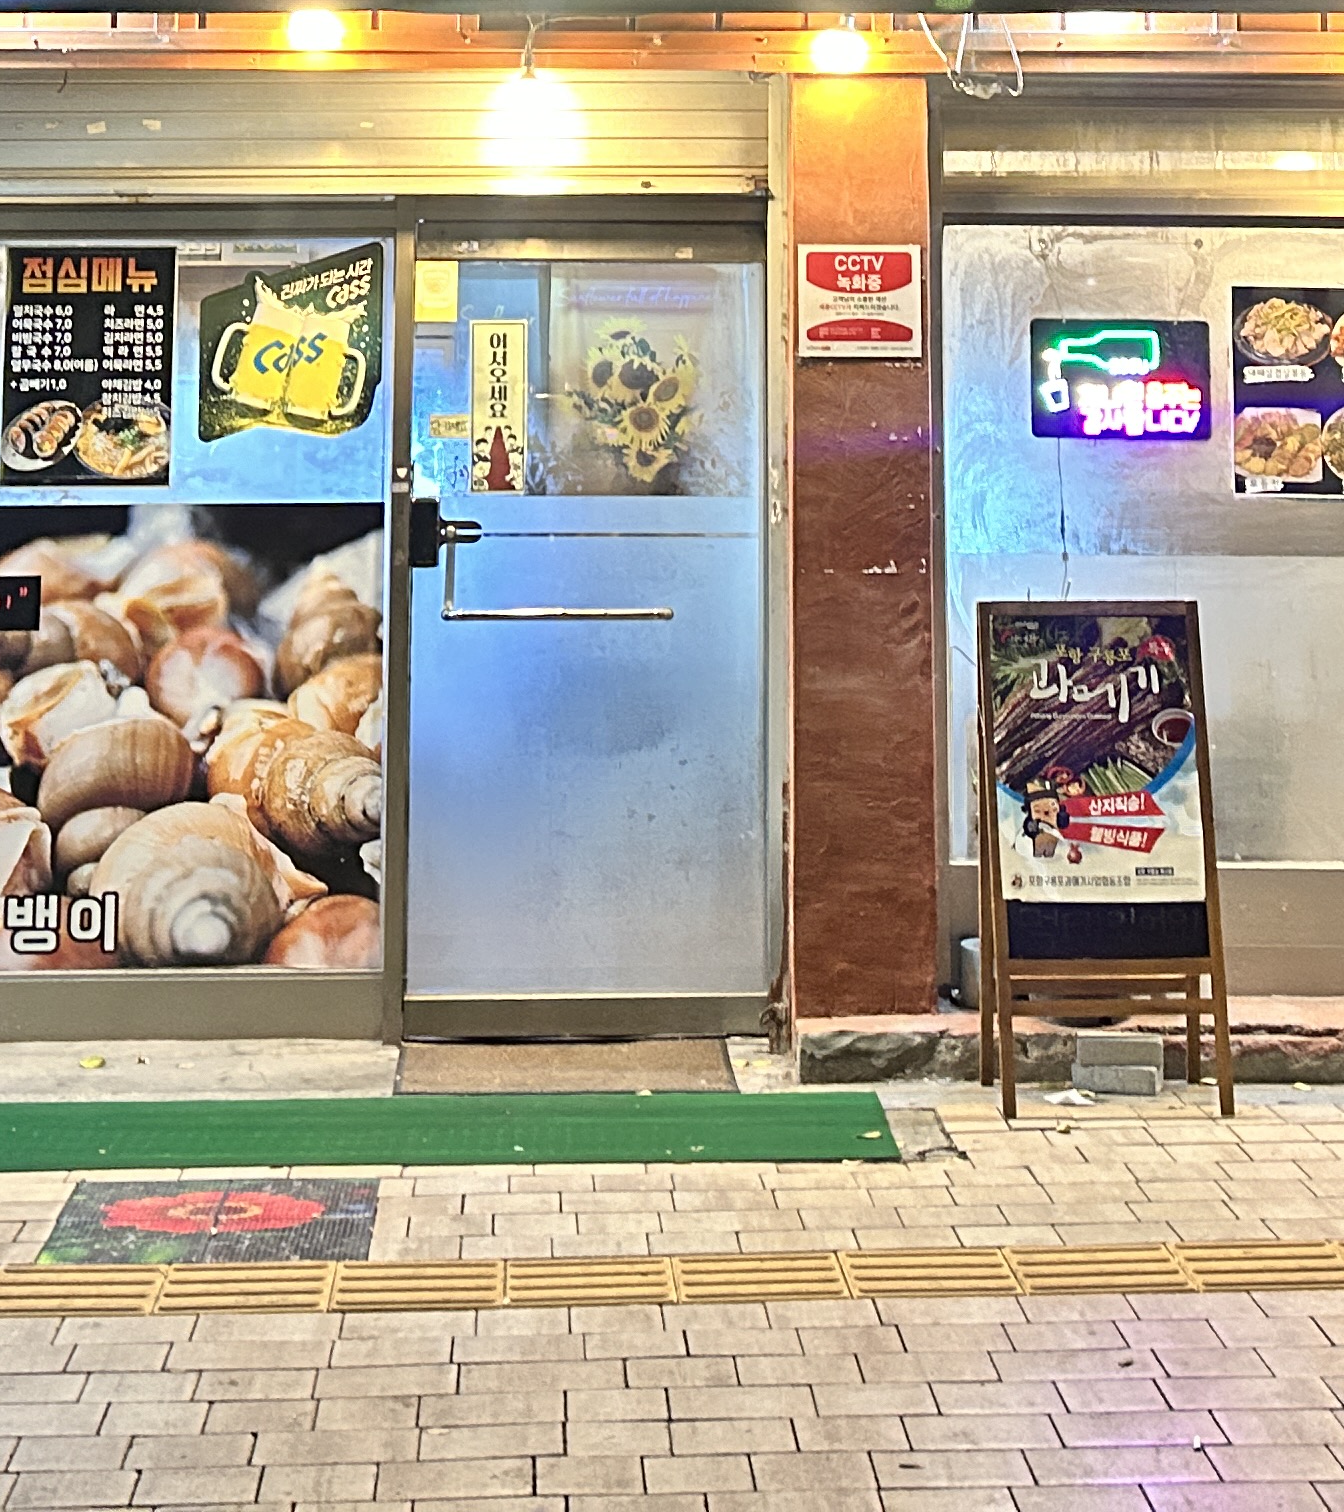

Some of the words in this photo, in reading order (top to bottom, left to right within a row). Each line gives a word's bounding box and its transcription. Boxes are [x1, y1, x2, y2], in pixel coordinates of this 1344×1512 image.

[22, 257, 158, 293] 점심메뉴
[834, 255, 884, 271] CCTV
[836, 274, 882, 291] 녹화중
[488, 332, 509, 419] 어서오세요
[1088, 792, 1146, 816] 산지직송!
